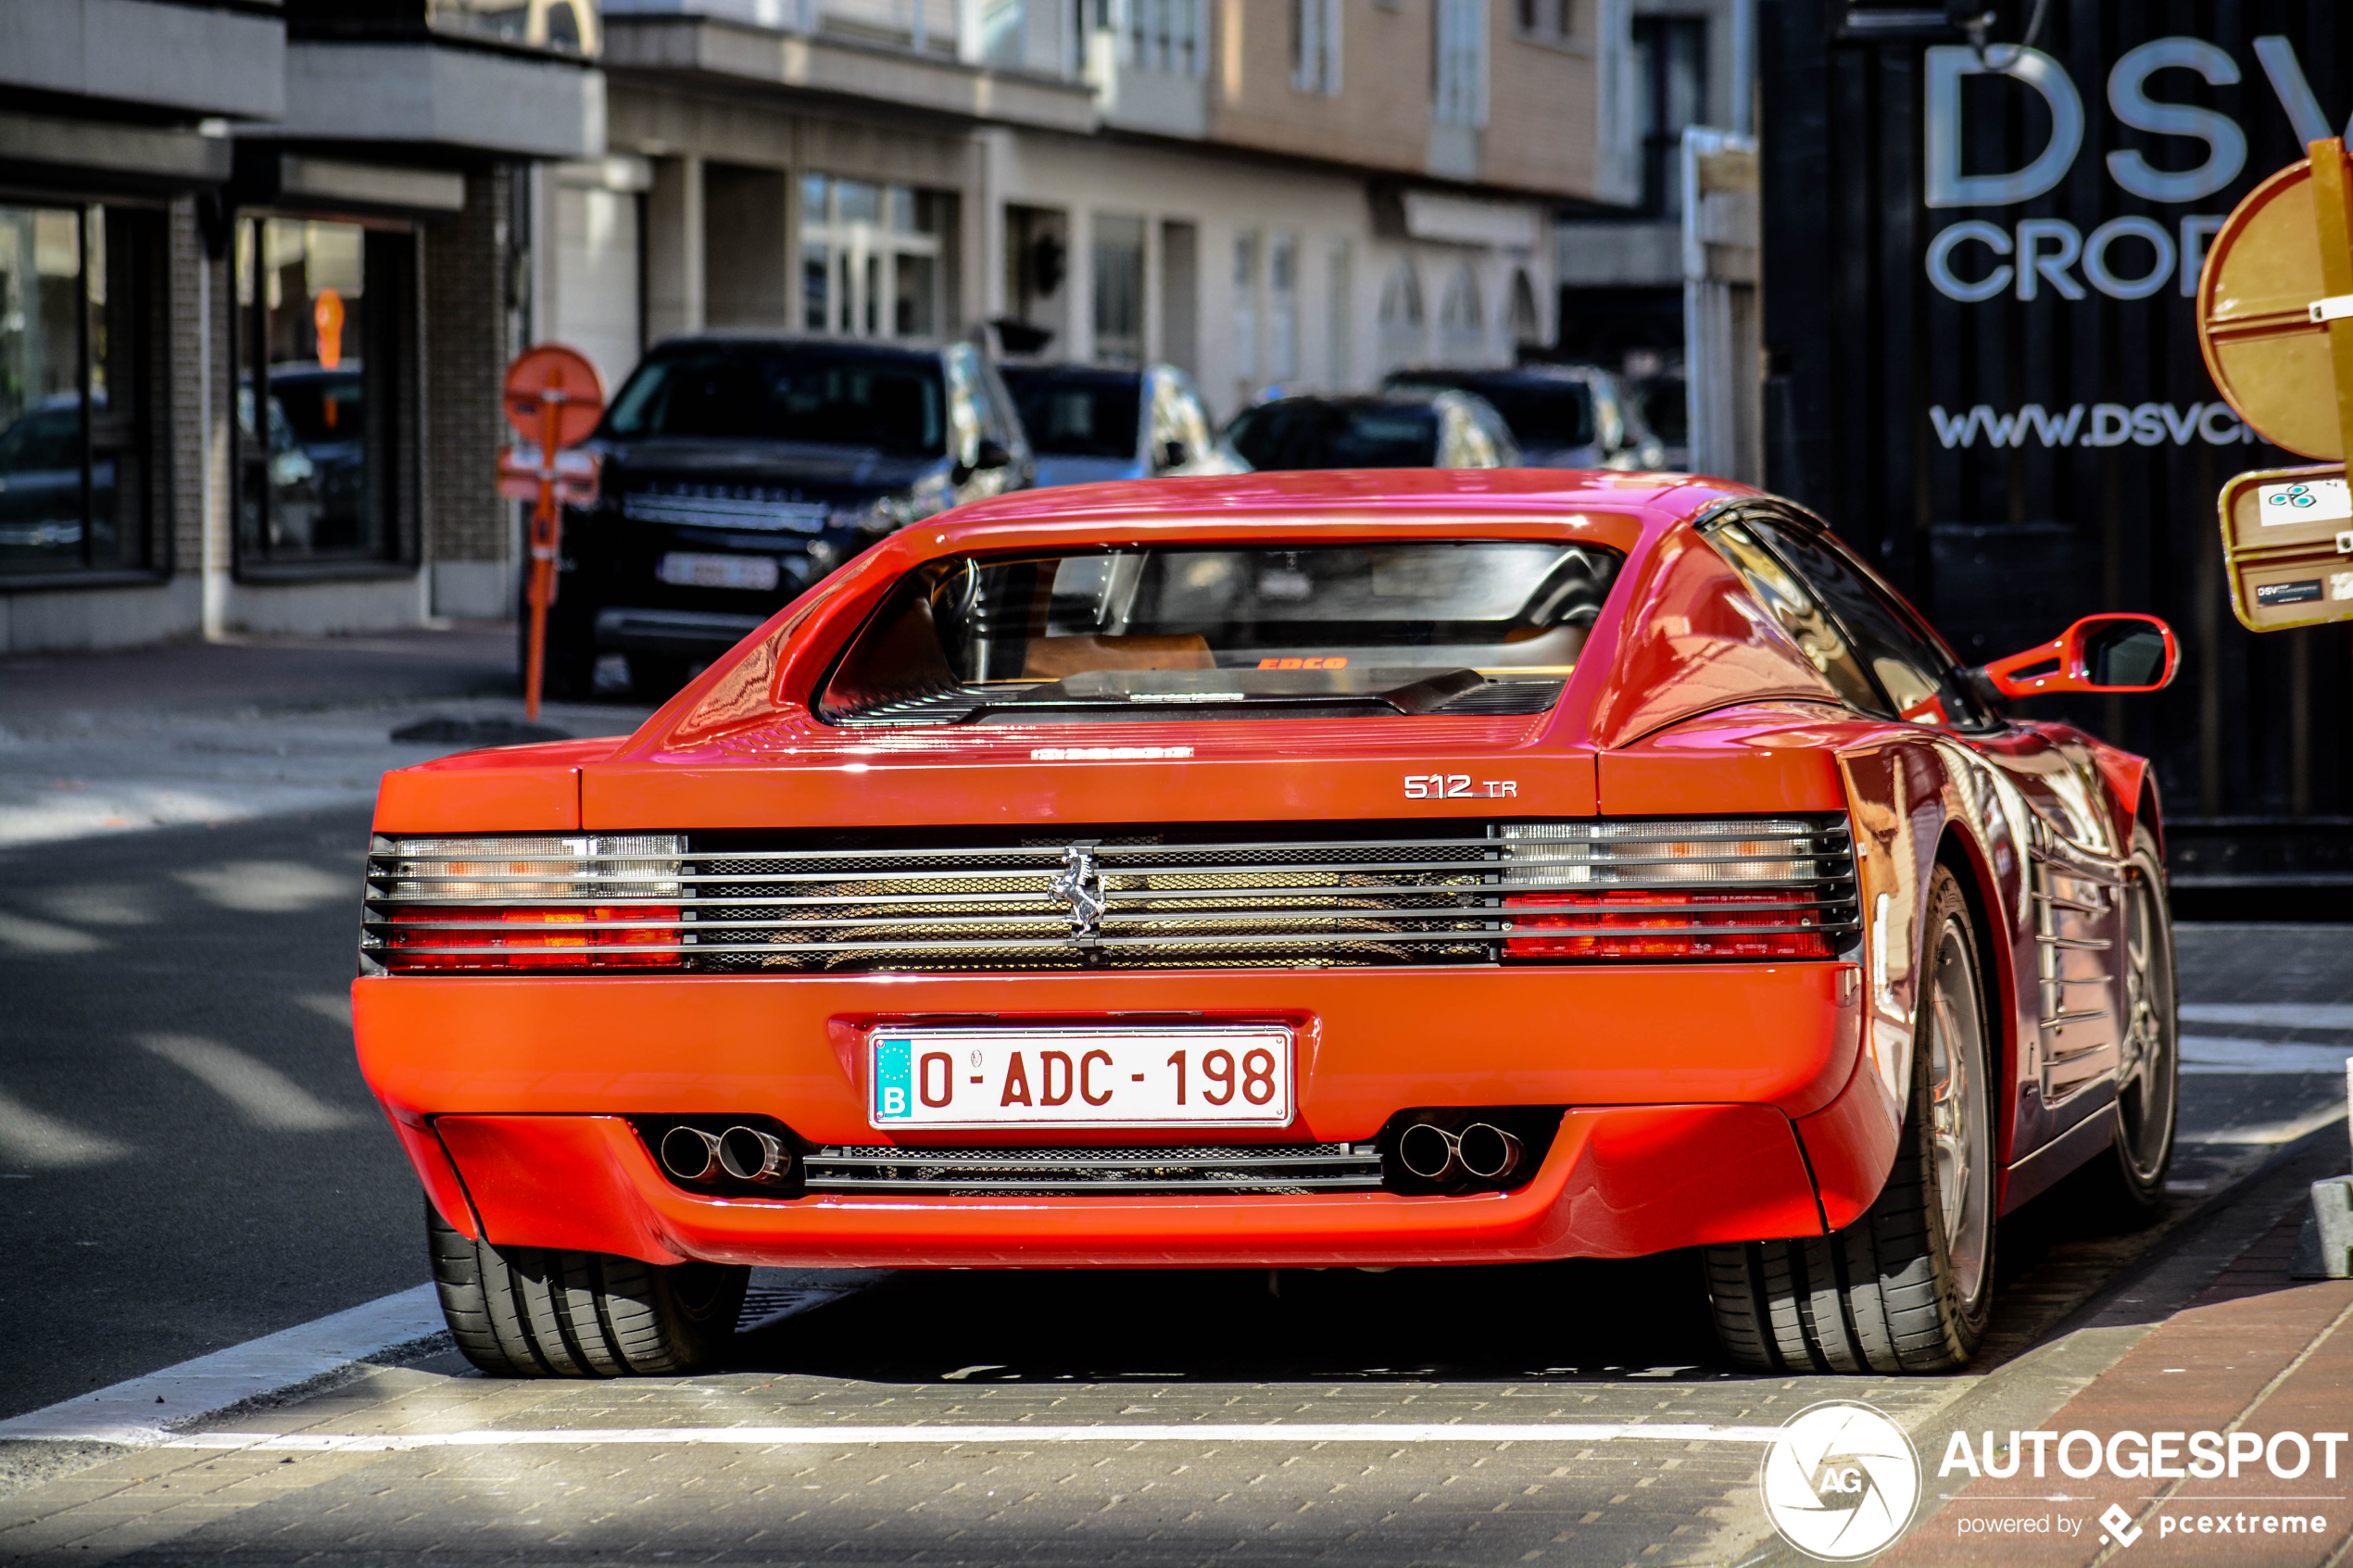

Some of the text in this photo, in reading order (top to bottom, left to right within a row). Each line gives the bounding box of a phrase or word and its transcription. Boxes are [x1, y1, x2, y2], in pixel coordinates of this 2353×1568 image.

[1257, 657, 1349, 670] EDCO
[1404, 774, 1517, 798] 512 TR
[884, 1086, 906, 1115] B
